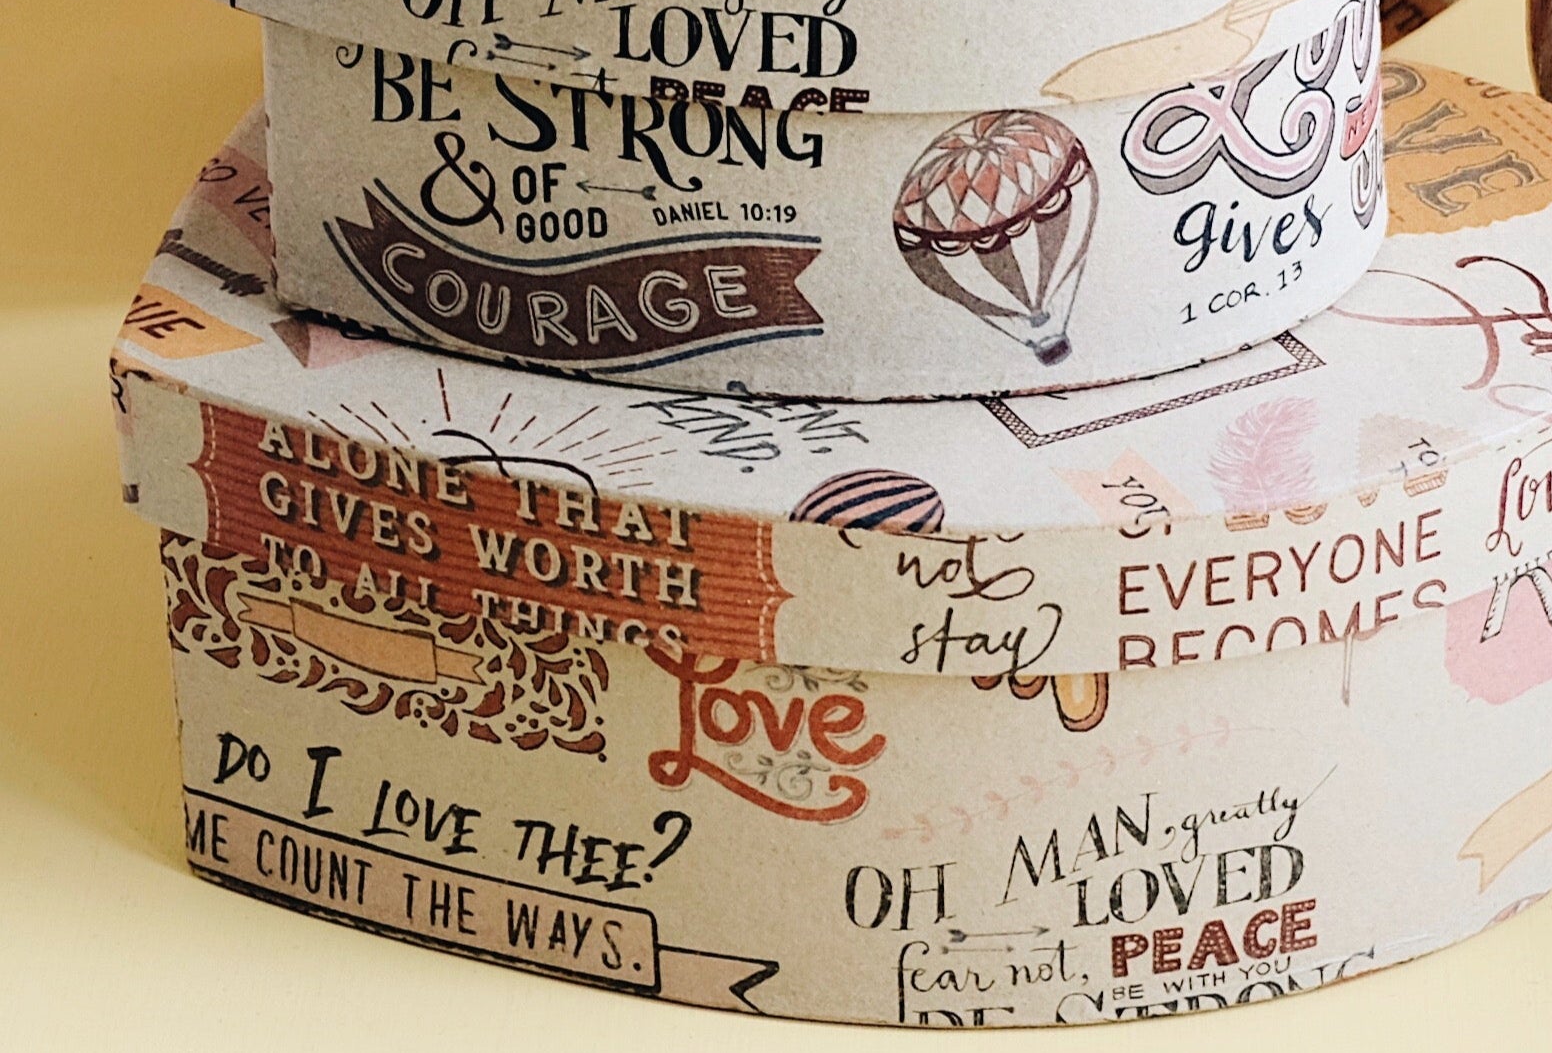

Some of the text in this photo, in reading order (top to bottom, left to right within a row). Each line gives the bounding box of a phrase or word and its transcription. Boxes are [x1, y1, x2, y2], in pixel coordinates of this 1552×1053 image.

[609, 5, 859, 78] LOVED
[372, 45, 826, 191] BE STRONG
[418, 130, 506, 234] &
[511, 163, 568, 207] OF
[651, 201, 799, 228] DANIEL 10:19
[515, 206, 609, 245] GOOD
[1172, 193, 1334, 274] gives
[381, 244, 760, 349] COURAGE
[1180, 259, 1305, 325] 1 COR. 13
[257, 419, 695, 549] ALONE THAT
[258, 470, 699, 609] GIVES WORTH
[898, 534, 1037, 603] not
[1118, 508, 1444, 615] EVERYONE
[261, 532, 324, 579] TO
[470, 592, 690, 658] THINGS
[900, 602, 1065, 686] stay
[643, 645, 887, 824] Love
[213, 732, 694, 891] DO I LOVE THEE?
[1179, 772, 1325, 864] greatly
[255, 828, 375, 908] COUNT
[401, 872, 480, 936] THE
[505, 898, 646, 974] WAYS.
[844, 860, 959, 931] OH
[1069, 843, 1306, 928] LOVED
[897, 939, 996, 1023] fear
[1005, 938, 1090, 988] not,
[1110, 897, 1320, 979] PEACE
[1112, 956, 1294, 1001] BE WITH YOU
